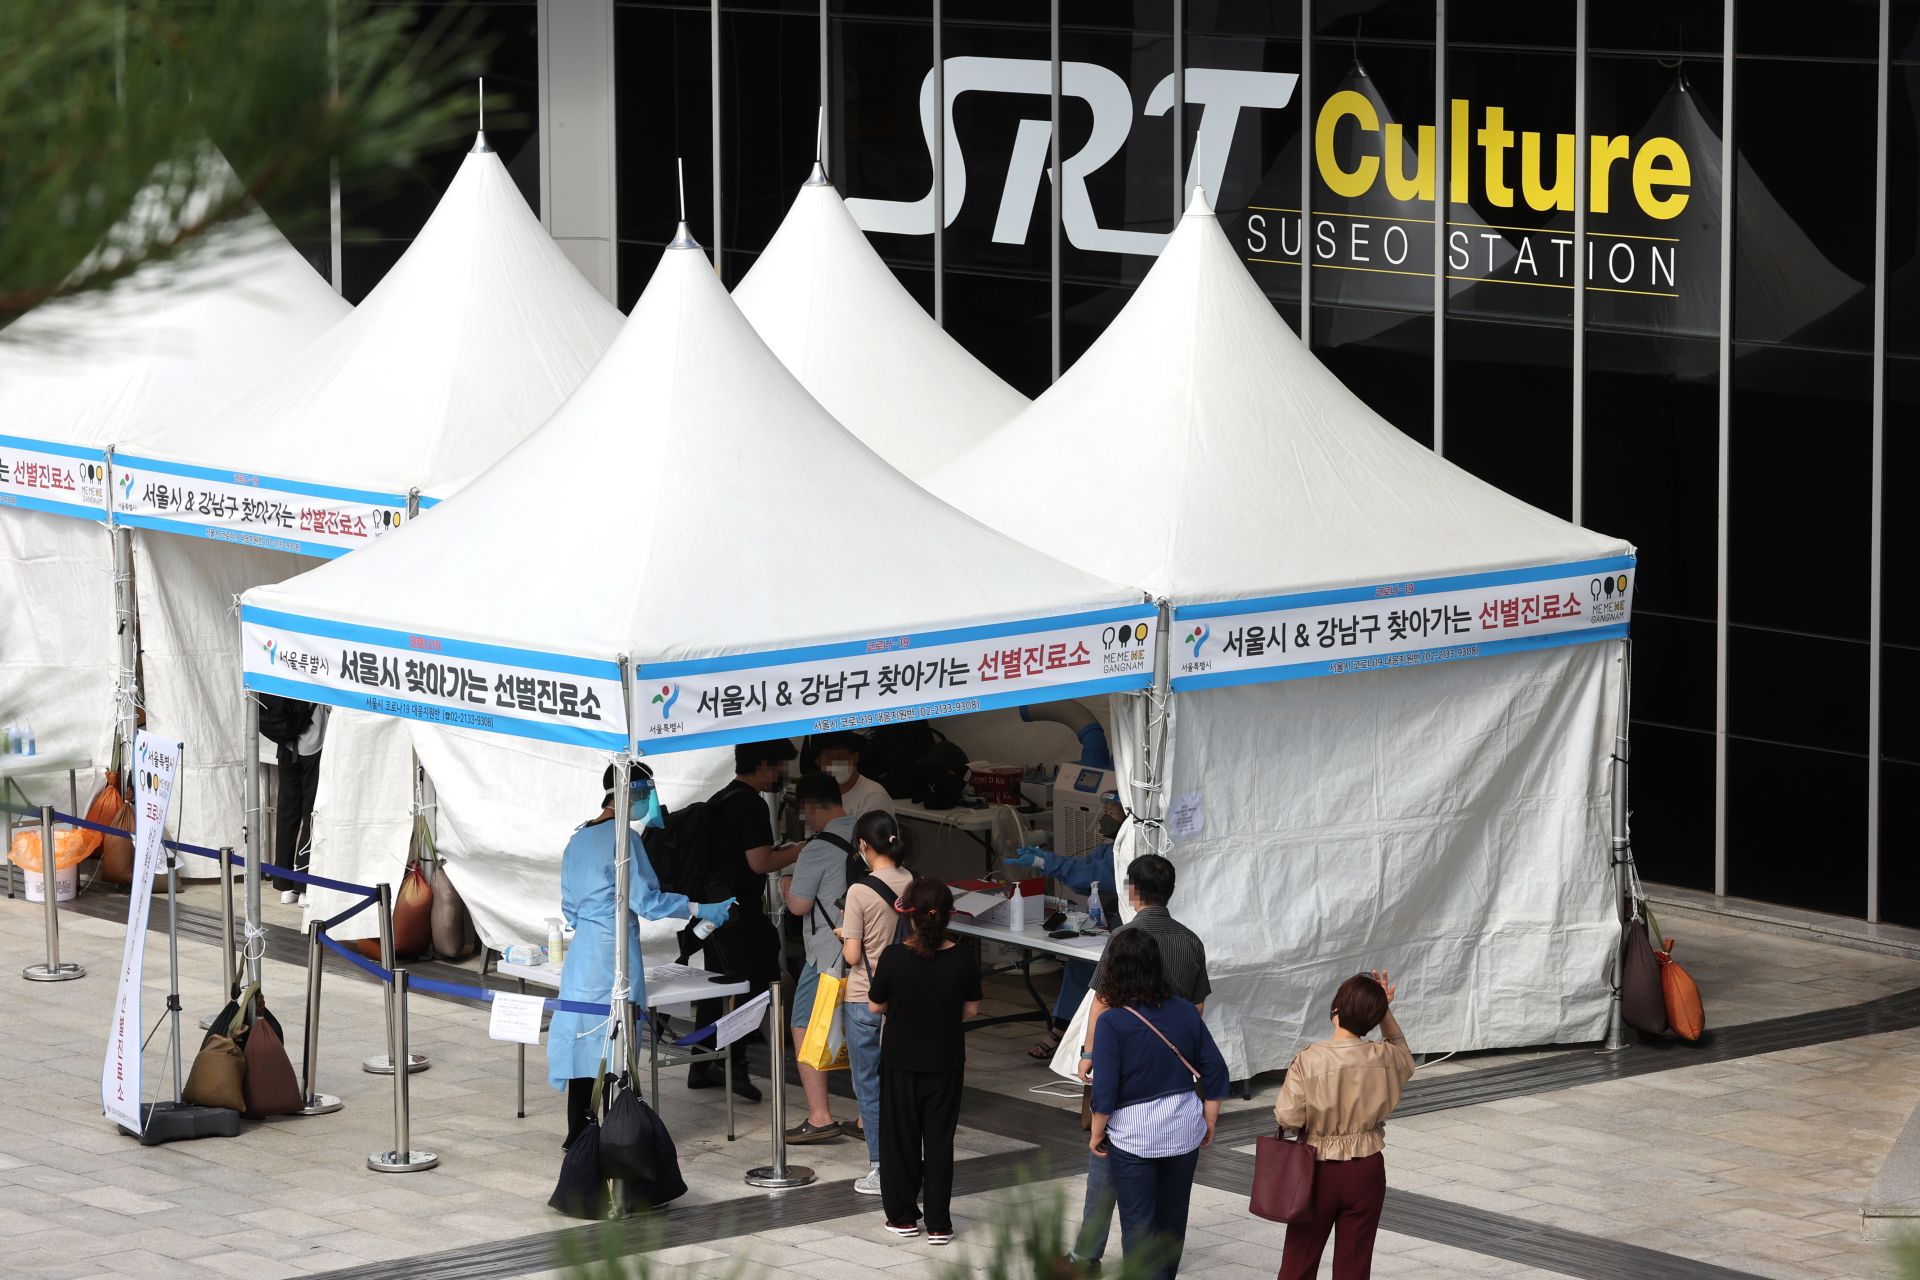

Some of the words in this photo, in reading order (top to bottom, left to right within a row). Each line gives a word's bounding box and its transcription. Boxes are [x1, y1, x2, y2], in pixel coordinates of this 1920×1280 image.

[846, 55, 1299, 256] SRT
[1315, 90, 1691, 220] Culture
[1247, 214, 1409, 266] SUSEO
[1448, 232, 1677, 287] STATION
[14, 461, 76, 491] 선별진료소
[142, 483, 182, 512] 서울시
[185, 491, 195, 511] &
[199, 492, 239, 519] 강남구
[241, 498, 296, 529] 찾아가는
[300, 507, 368, 538] 선별진료소
[1376, 583, 1415, 597] 코로나-19
[1222, 622, 1286, 658] 서울시
[1294, 623, 1311, 648] &
[1316, 614, 1381, 649] 강남구
[1387, 604, 1472, 641] 찾아가는
[1478, 592, 1582, 630] 선별진료소
[1591, 612, 1624, 624] GANGNAM
[866, 637, 911, 652] 코로나-19
[697, 680, 767, 718] 서울시
[775, 680, 793, 707] &
[799, 669, 870, 706] 강남구
[877, 657, 971, 696] 찾아가는
[977, 640, 1091, 682] 선별진료소
[1103, 661, 1144, 674] GANGNAM
[1181, 660, 1212, 672] 서울특별시
[1329, 662, 1351, 674] 서울시
[1353, 657, 1383, 671] 코로나19
[279, 650, 330, 676] 서울특별시
[340, 649, 400, 690] 서울시
[405, 659, 488, 704] 찾아가는
[494, 673, 602, 721] 선별진료소
[366, 697, 384, 711] 서울시
[385, 700, 410, 714] 코로나19
[411, 705, 440, 720] 대응지원반
[814, 719, 838, 731] 서울시
[841, 714, 873, 728] 코로나19
[875, 708, 915, 724] 대응지원반
[918, 700, 981, 717] (02-2133-9308)
[649, 721, 684, 735] 서울특별시
